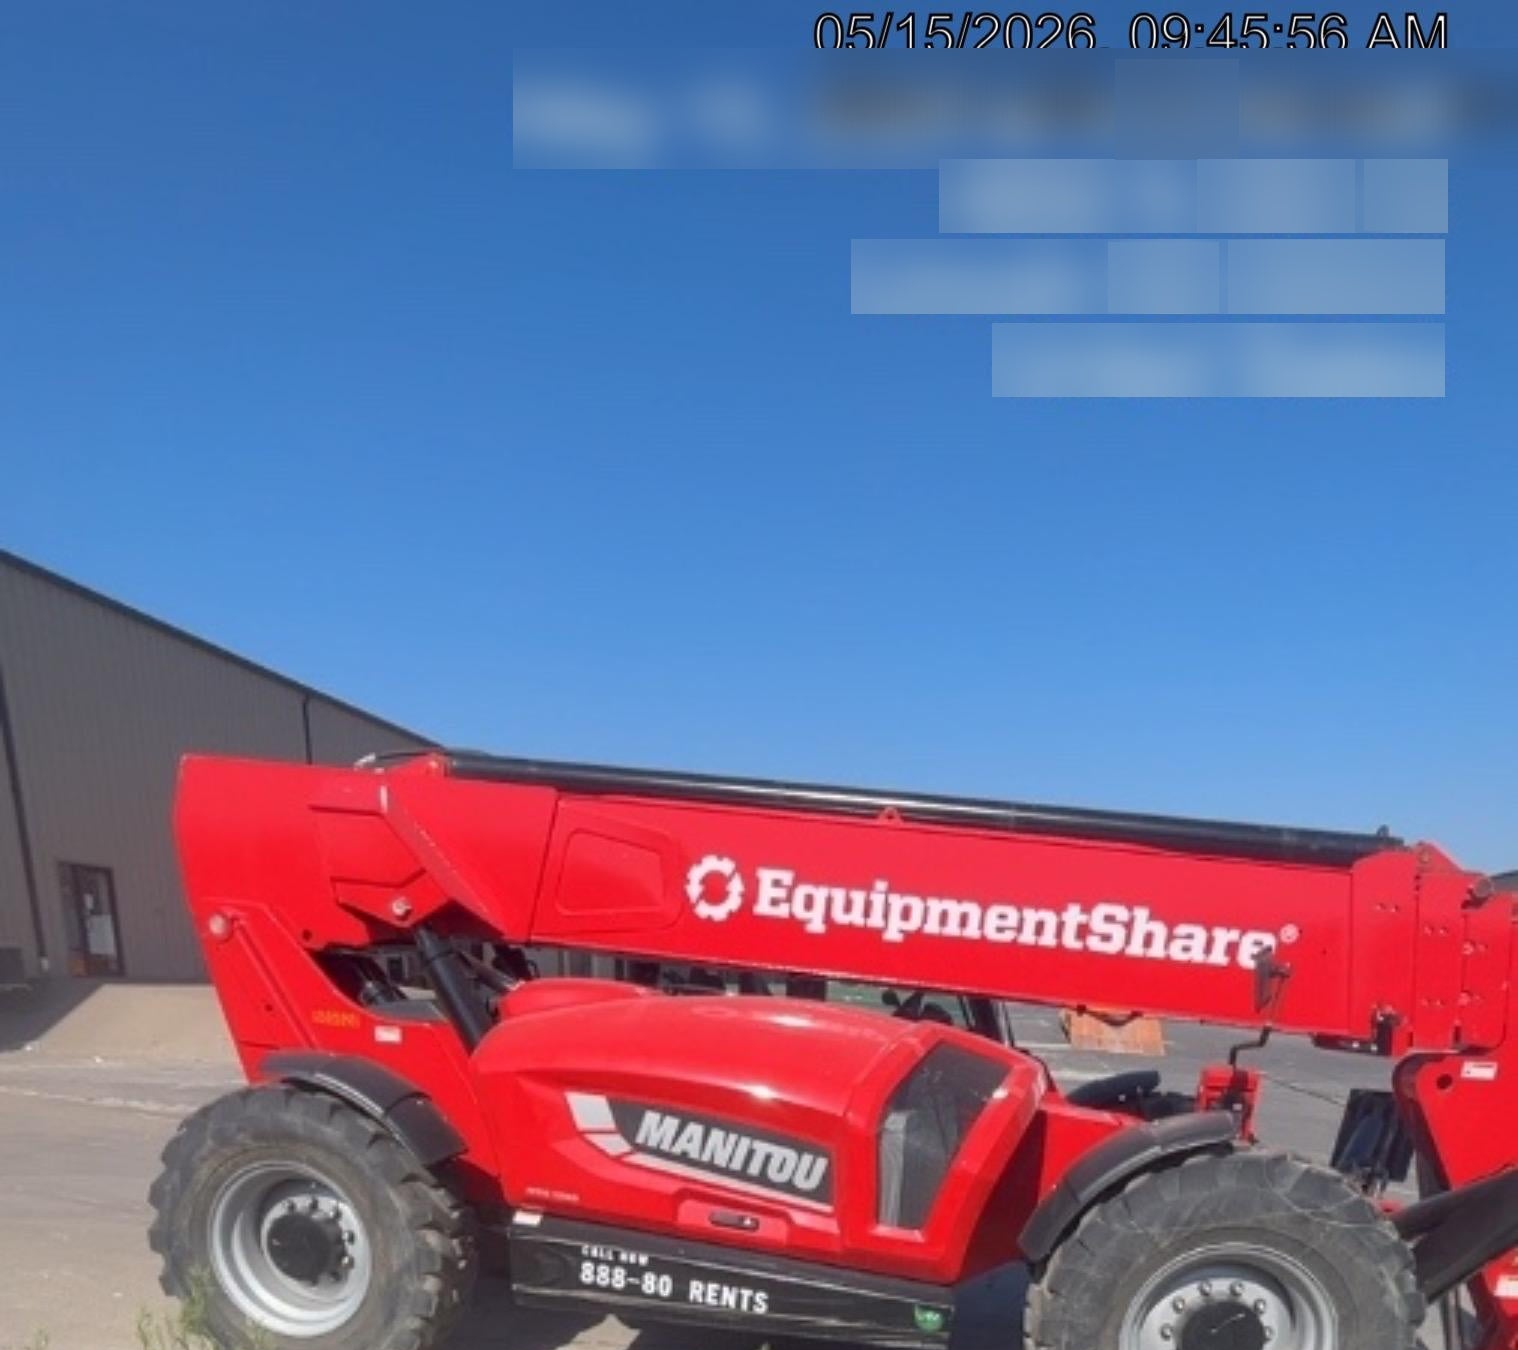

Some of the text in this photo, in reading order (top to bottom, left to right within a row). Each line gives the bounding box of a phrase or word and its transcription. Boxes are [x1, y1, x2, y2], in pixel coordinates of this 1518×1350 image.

[635, 1109, 829, 1191] MANITOU
[579, 1261, 769, 1315] 888-80 RENTS
